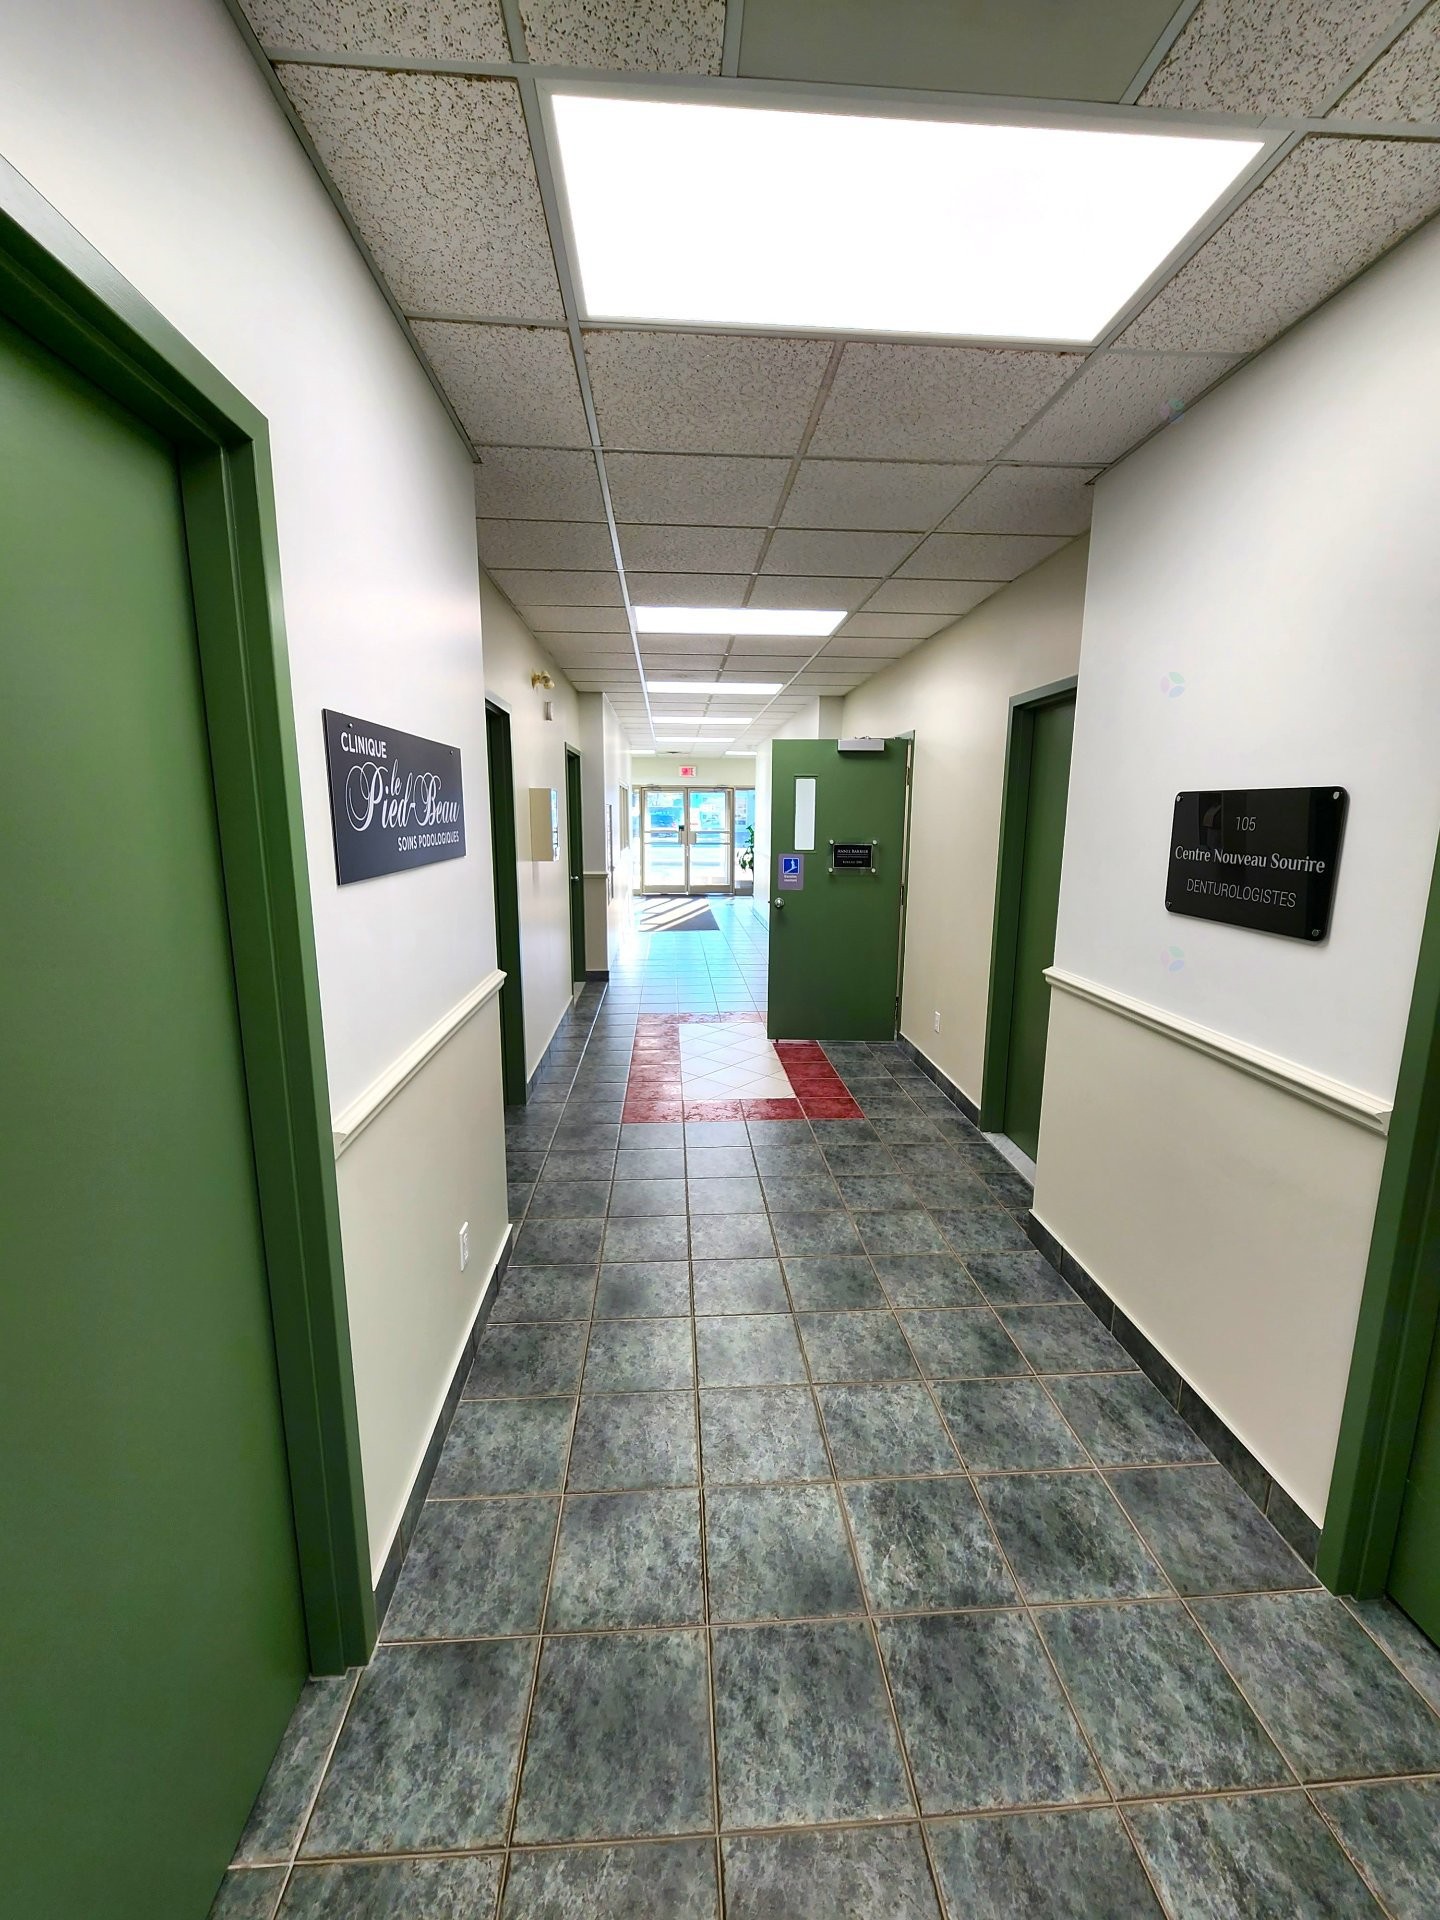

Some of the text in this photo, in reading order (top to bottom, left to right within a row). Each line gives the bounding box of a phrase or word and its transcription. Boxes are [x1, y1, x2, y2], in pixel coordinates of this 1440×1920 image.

[340, 731, 388, 759] CLINIQUE
[390, 758, 402, 797] le
[1235, 816, 1257, 832] 105
[397, 830, 460, 852] SOINS PODOLOGIQUES
[1175, 845, 1326, 874] Centre Nouveau Sourire
[1186, 878, 1297, 908] DENTUROLOGISTES
